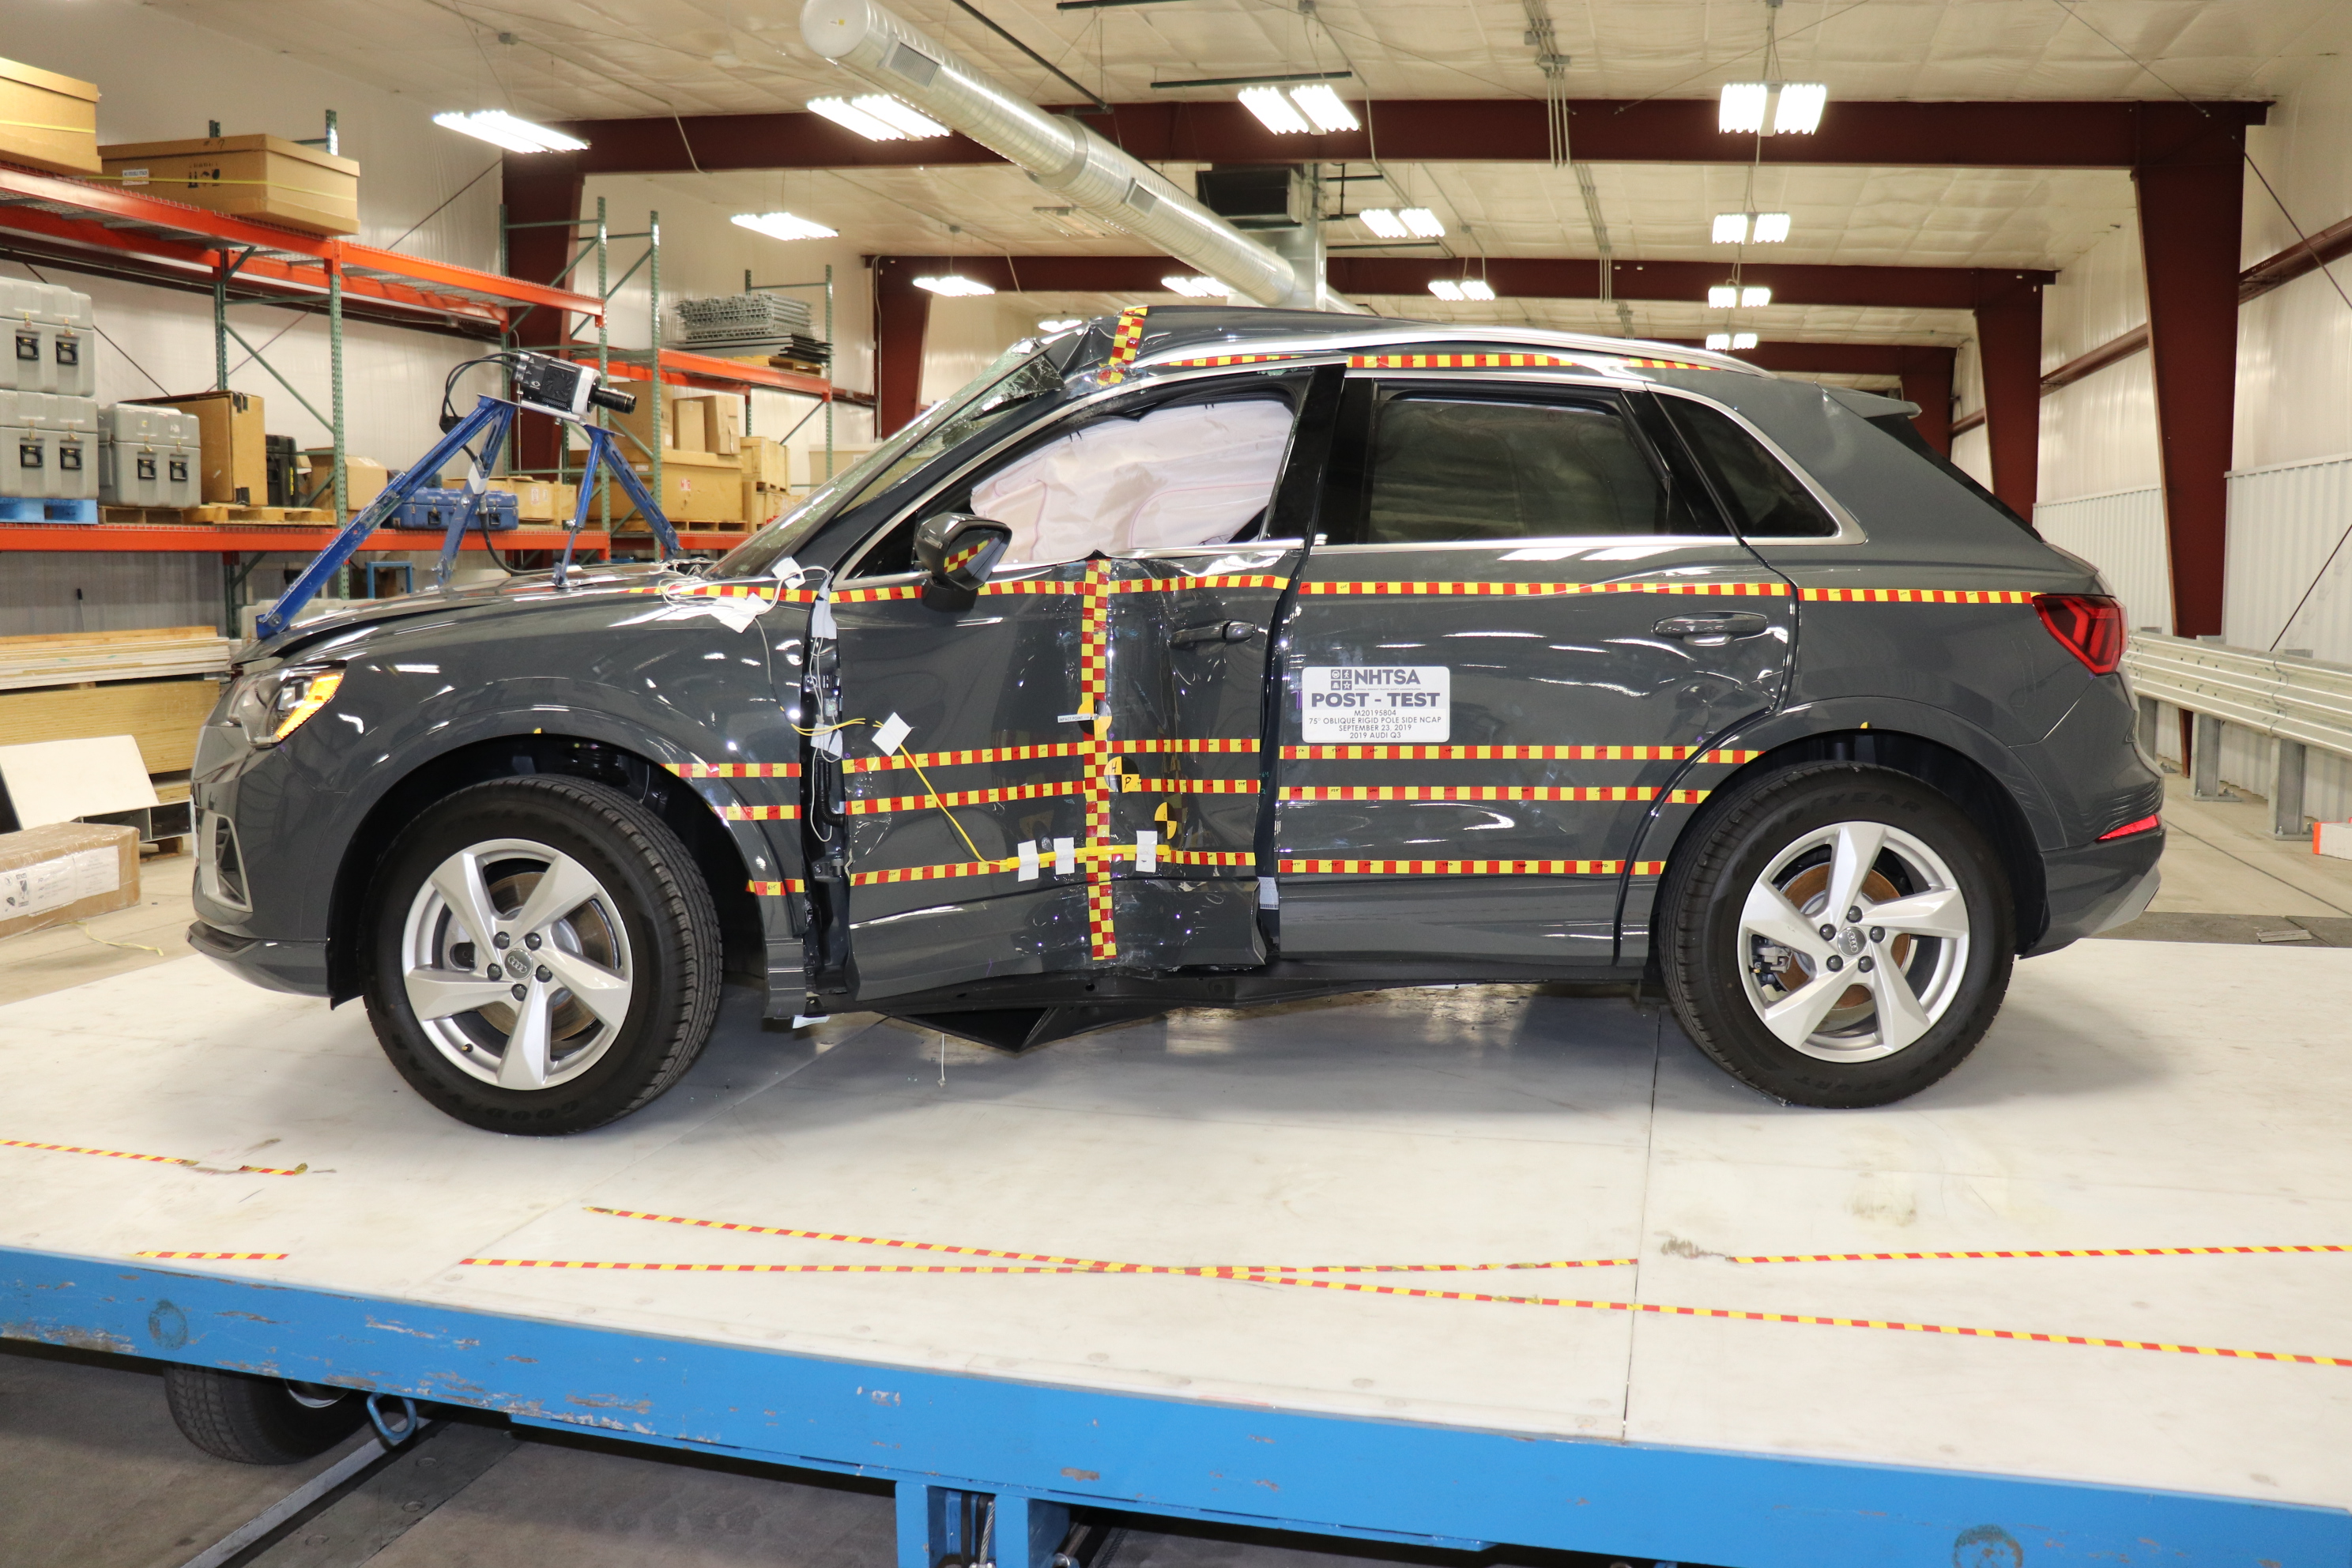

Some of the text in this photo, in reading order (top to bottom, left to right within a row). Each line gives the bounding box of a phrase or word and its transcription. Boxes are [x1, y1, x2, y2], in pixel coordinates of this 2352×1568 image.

[1355, 669, 1421, 685] NHTSA
[1311, 692, 1370, 707] POST
[1387, 692, 1441, 707] TEST
